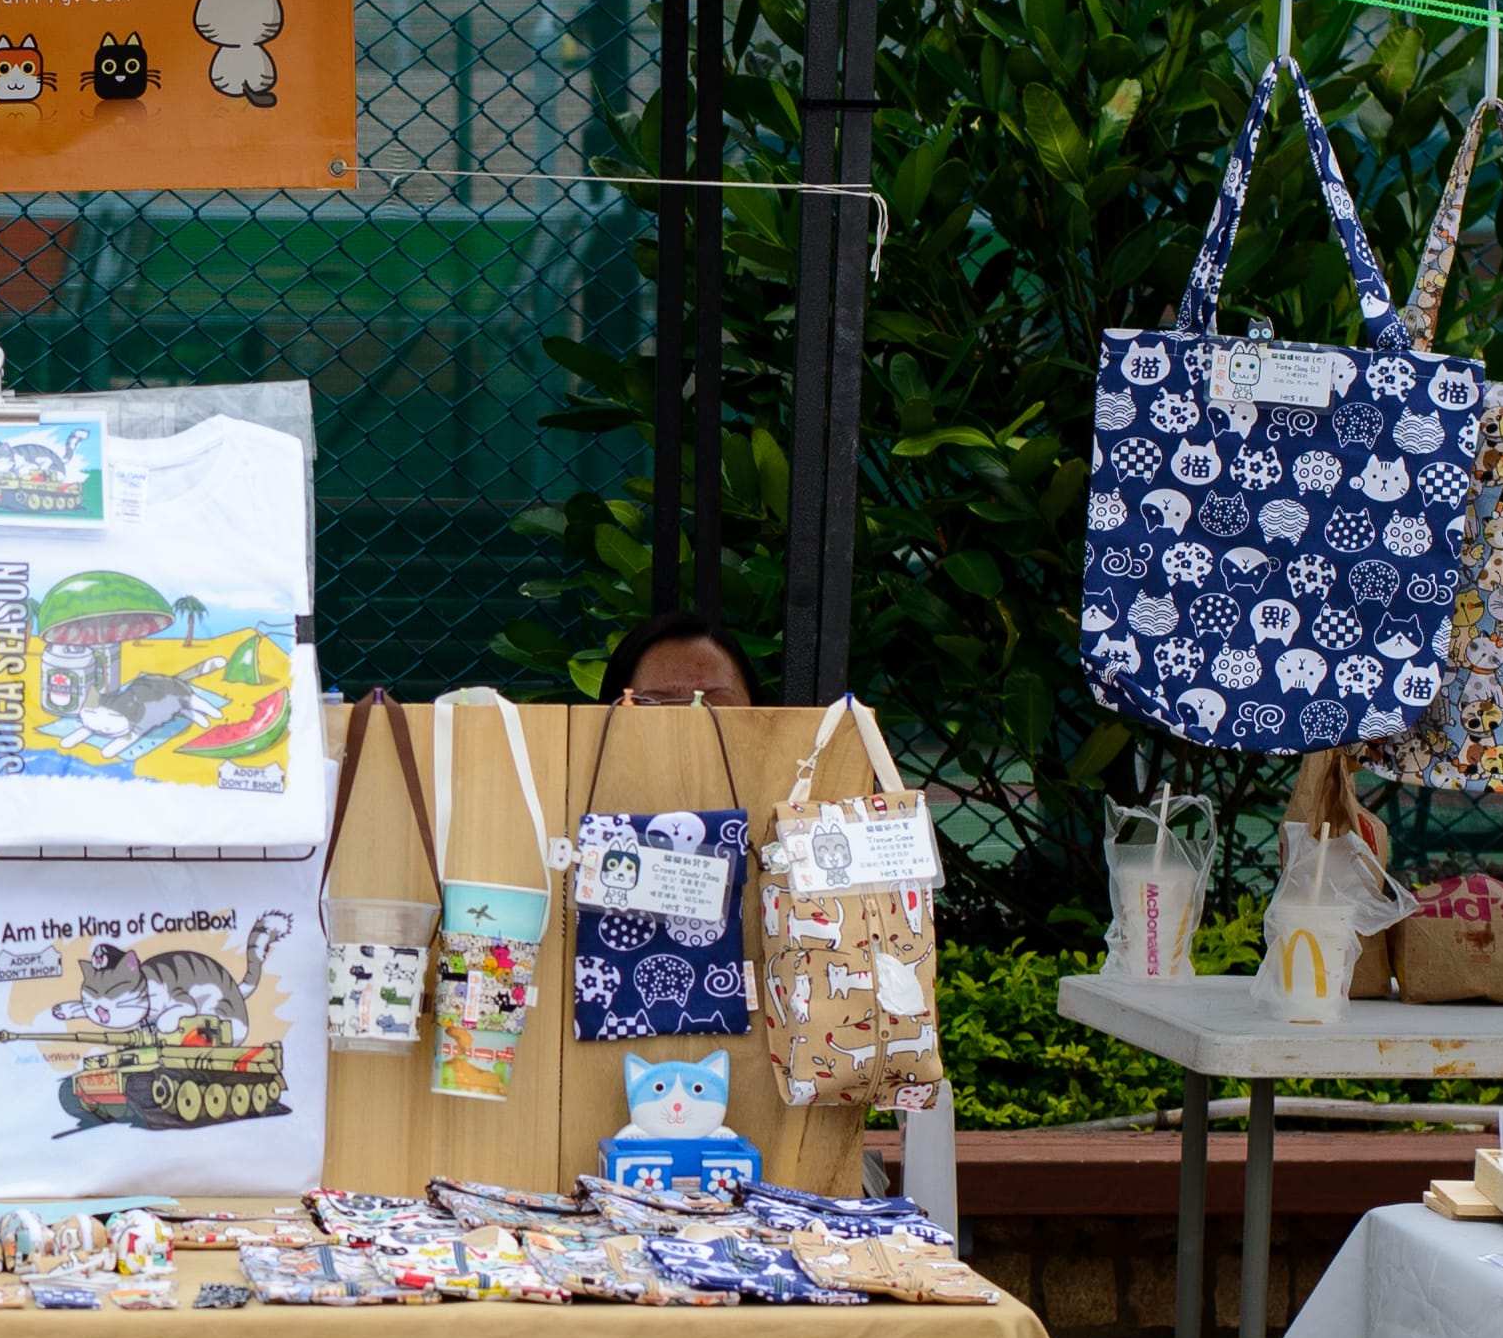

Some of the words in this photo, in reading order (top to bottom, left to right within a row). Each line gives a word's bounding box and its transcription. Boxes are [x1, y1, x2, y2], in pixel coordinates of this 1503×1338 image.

[1, 923, 36, 943] Am
[41, 919, 73, 939] the
[78, 915, 121, 939] King
[126, 913, 145, 934] of
[150, 909, 237, 934] CardBox!
[1146, 882, 1160, 977] McDonald's
[10, 955, 44, 967] ADOPT,
[0, 967, 27, 980] DON'T
